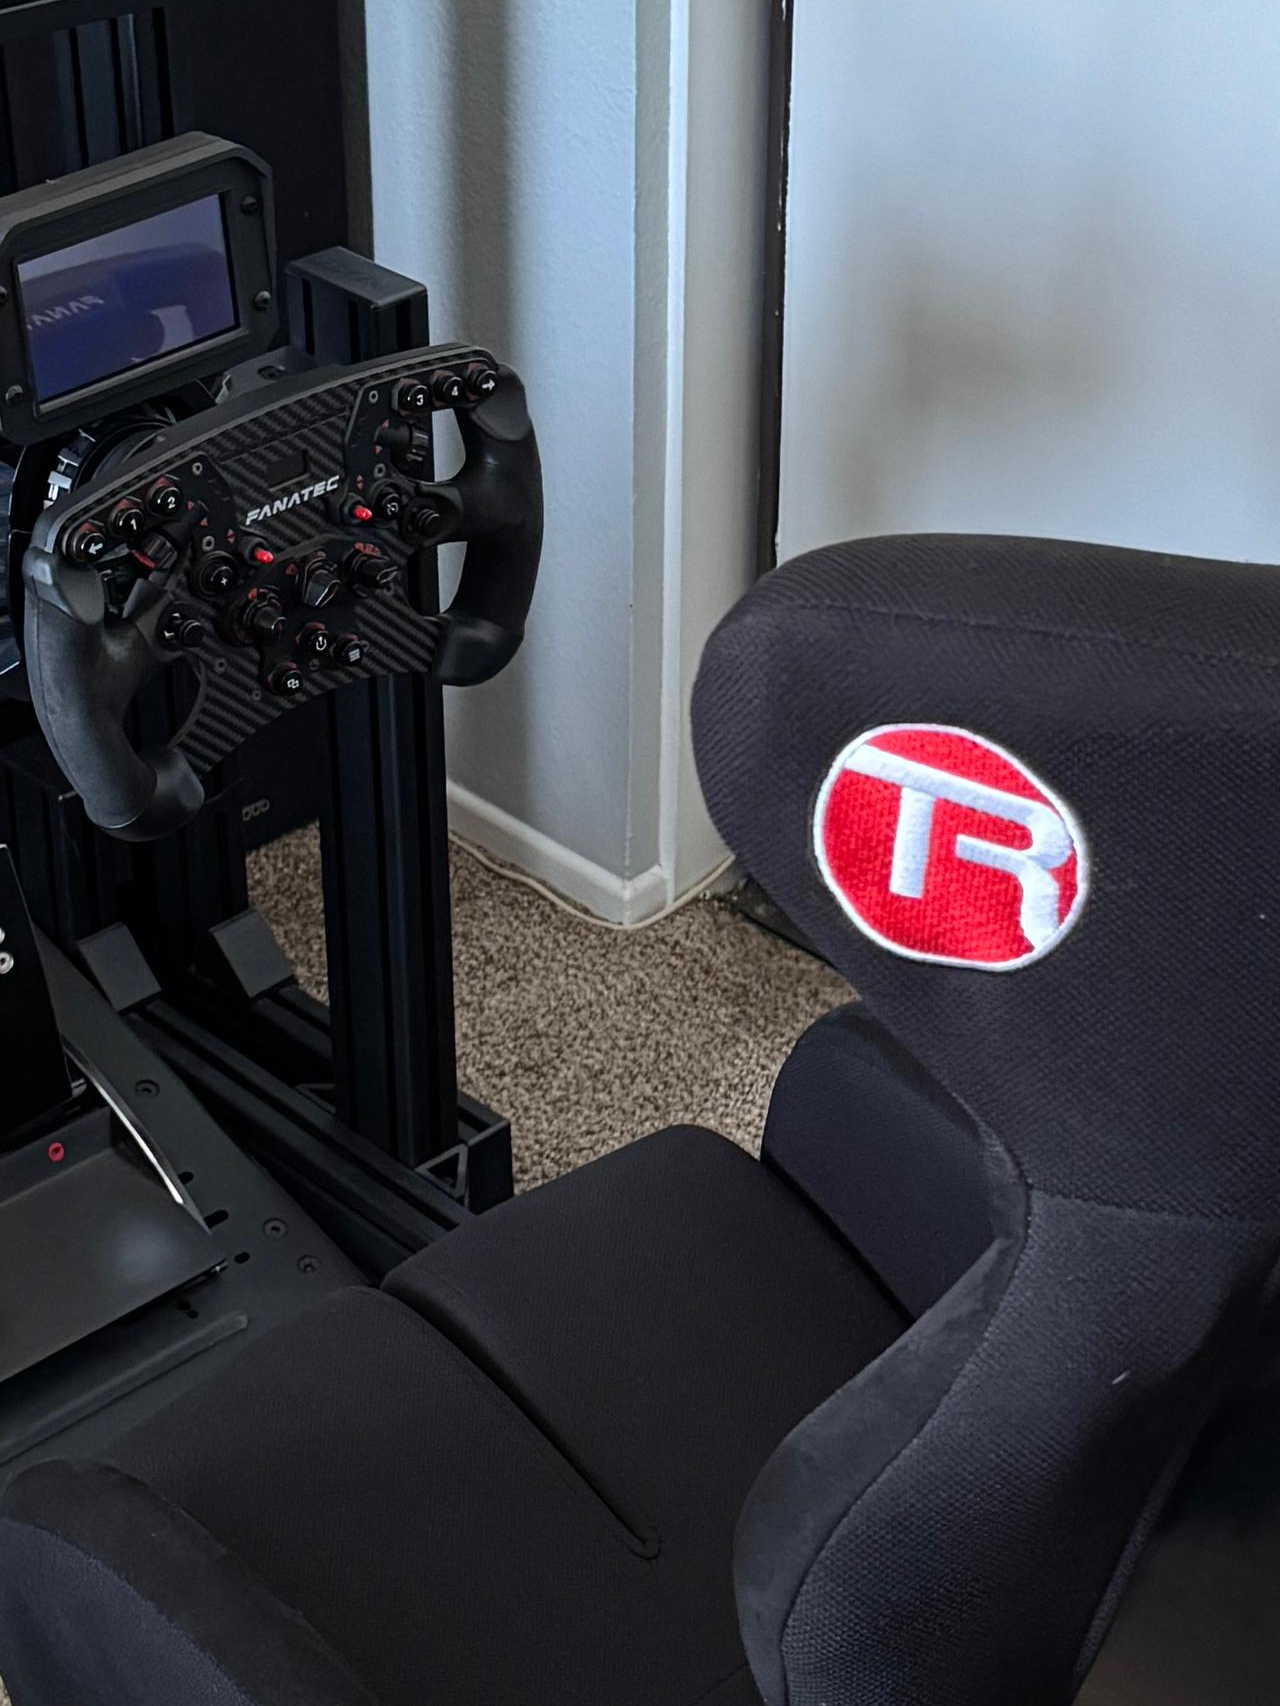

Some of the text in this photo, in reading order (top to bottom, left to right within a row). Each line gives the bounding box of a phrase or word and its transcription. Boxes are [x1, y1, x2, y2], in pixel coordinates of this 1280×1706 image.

[415, 394, 424, 406] 3
[166, 497, 176, 510] 2
[245, 475, 340, 526] FANATEC
[130, 518, 137, 531] 1
[843, 744, 1071, 951] TR
